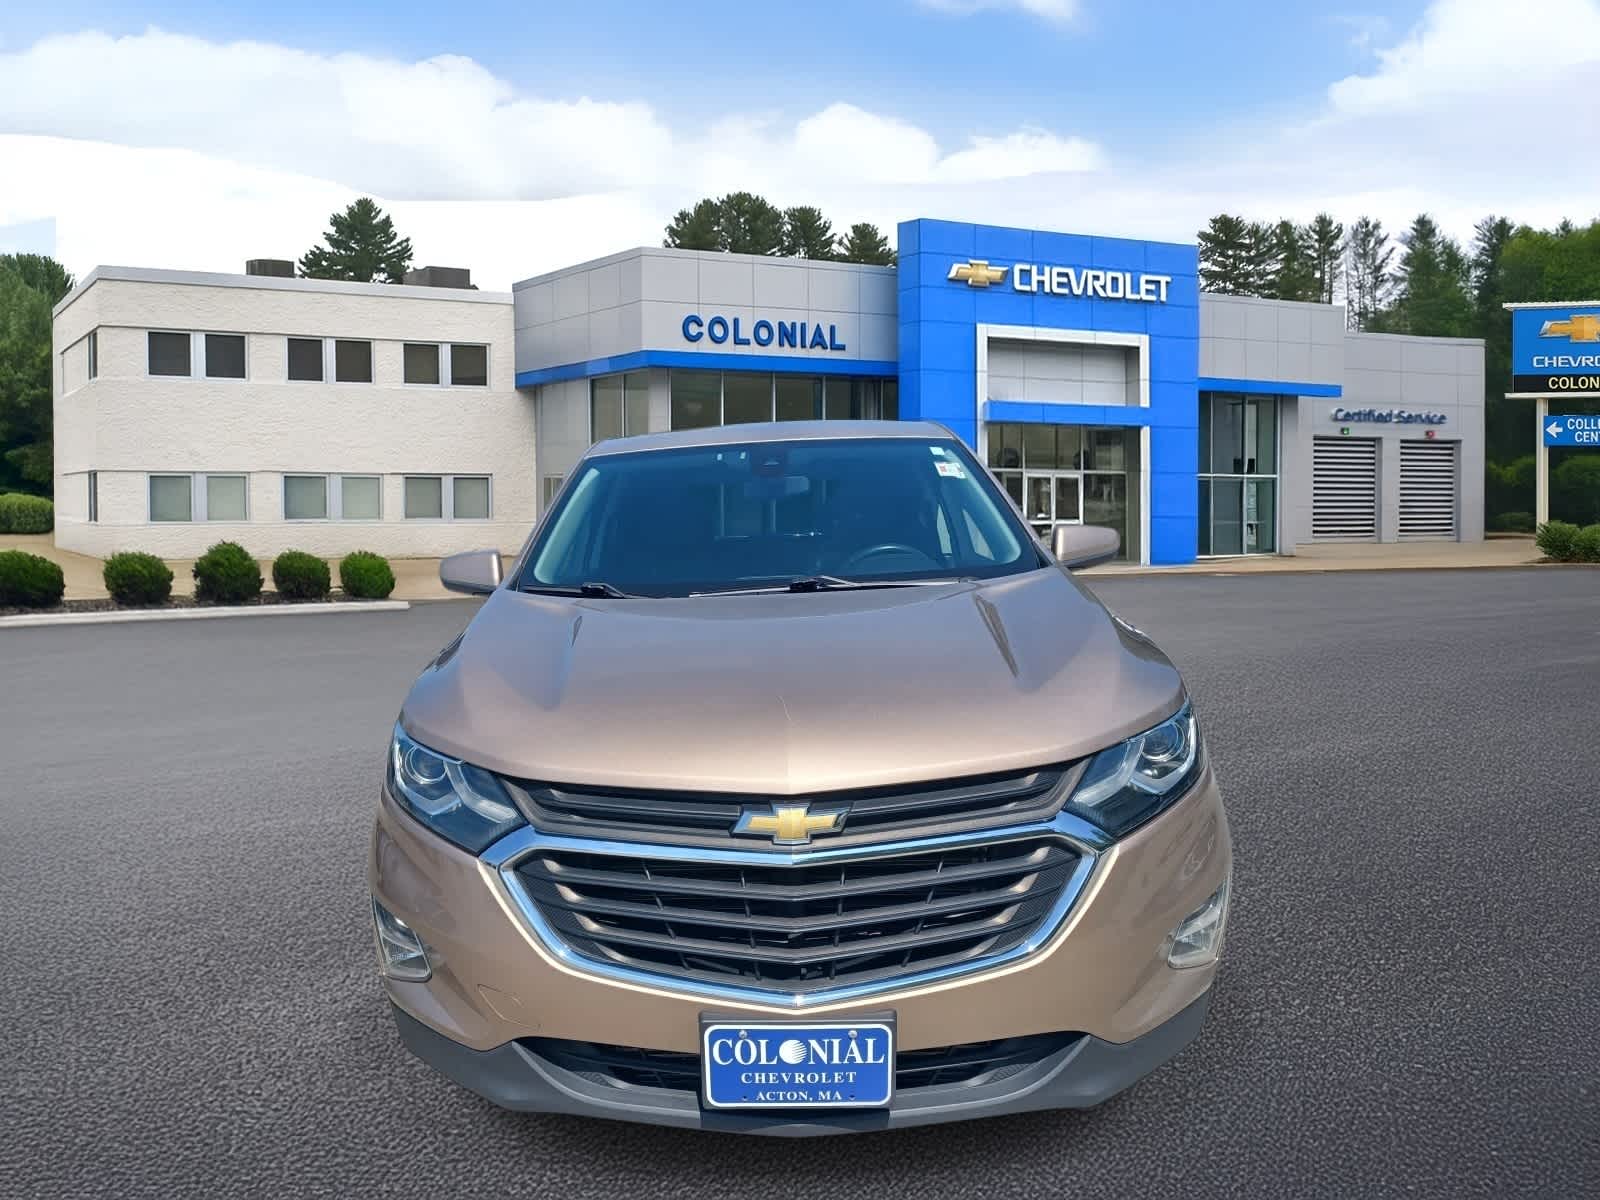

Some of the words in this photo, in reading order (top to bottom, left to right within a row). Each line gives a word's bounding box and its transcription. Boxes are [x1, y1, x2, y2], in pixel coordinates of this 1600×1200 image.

[1013, 262, 1171, 302] CHEVROLET
[682, 314, 846, 351] COLONIAL
[1332, 408, 1393, 424] Certified
[1395, 410, 1447, 425] Service
[1575, 431, 1600, 443] CEN
[712, 1038, 885, 1066] COLONIAL
[741, 1071, 857, 1085] CHEVROLET
[756, 1091, 814, 1102] ACTON,
[818, 1090, 843, 1101] MA
